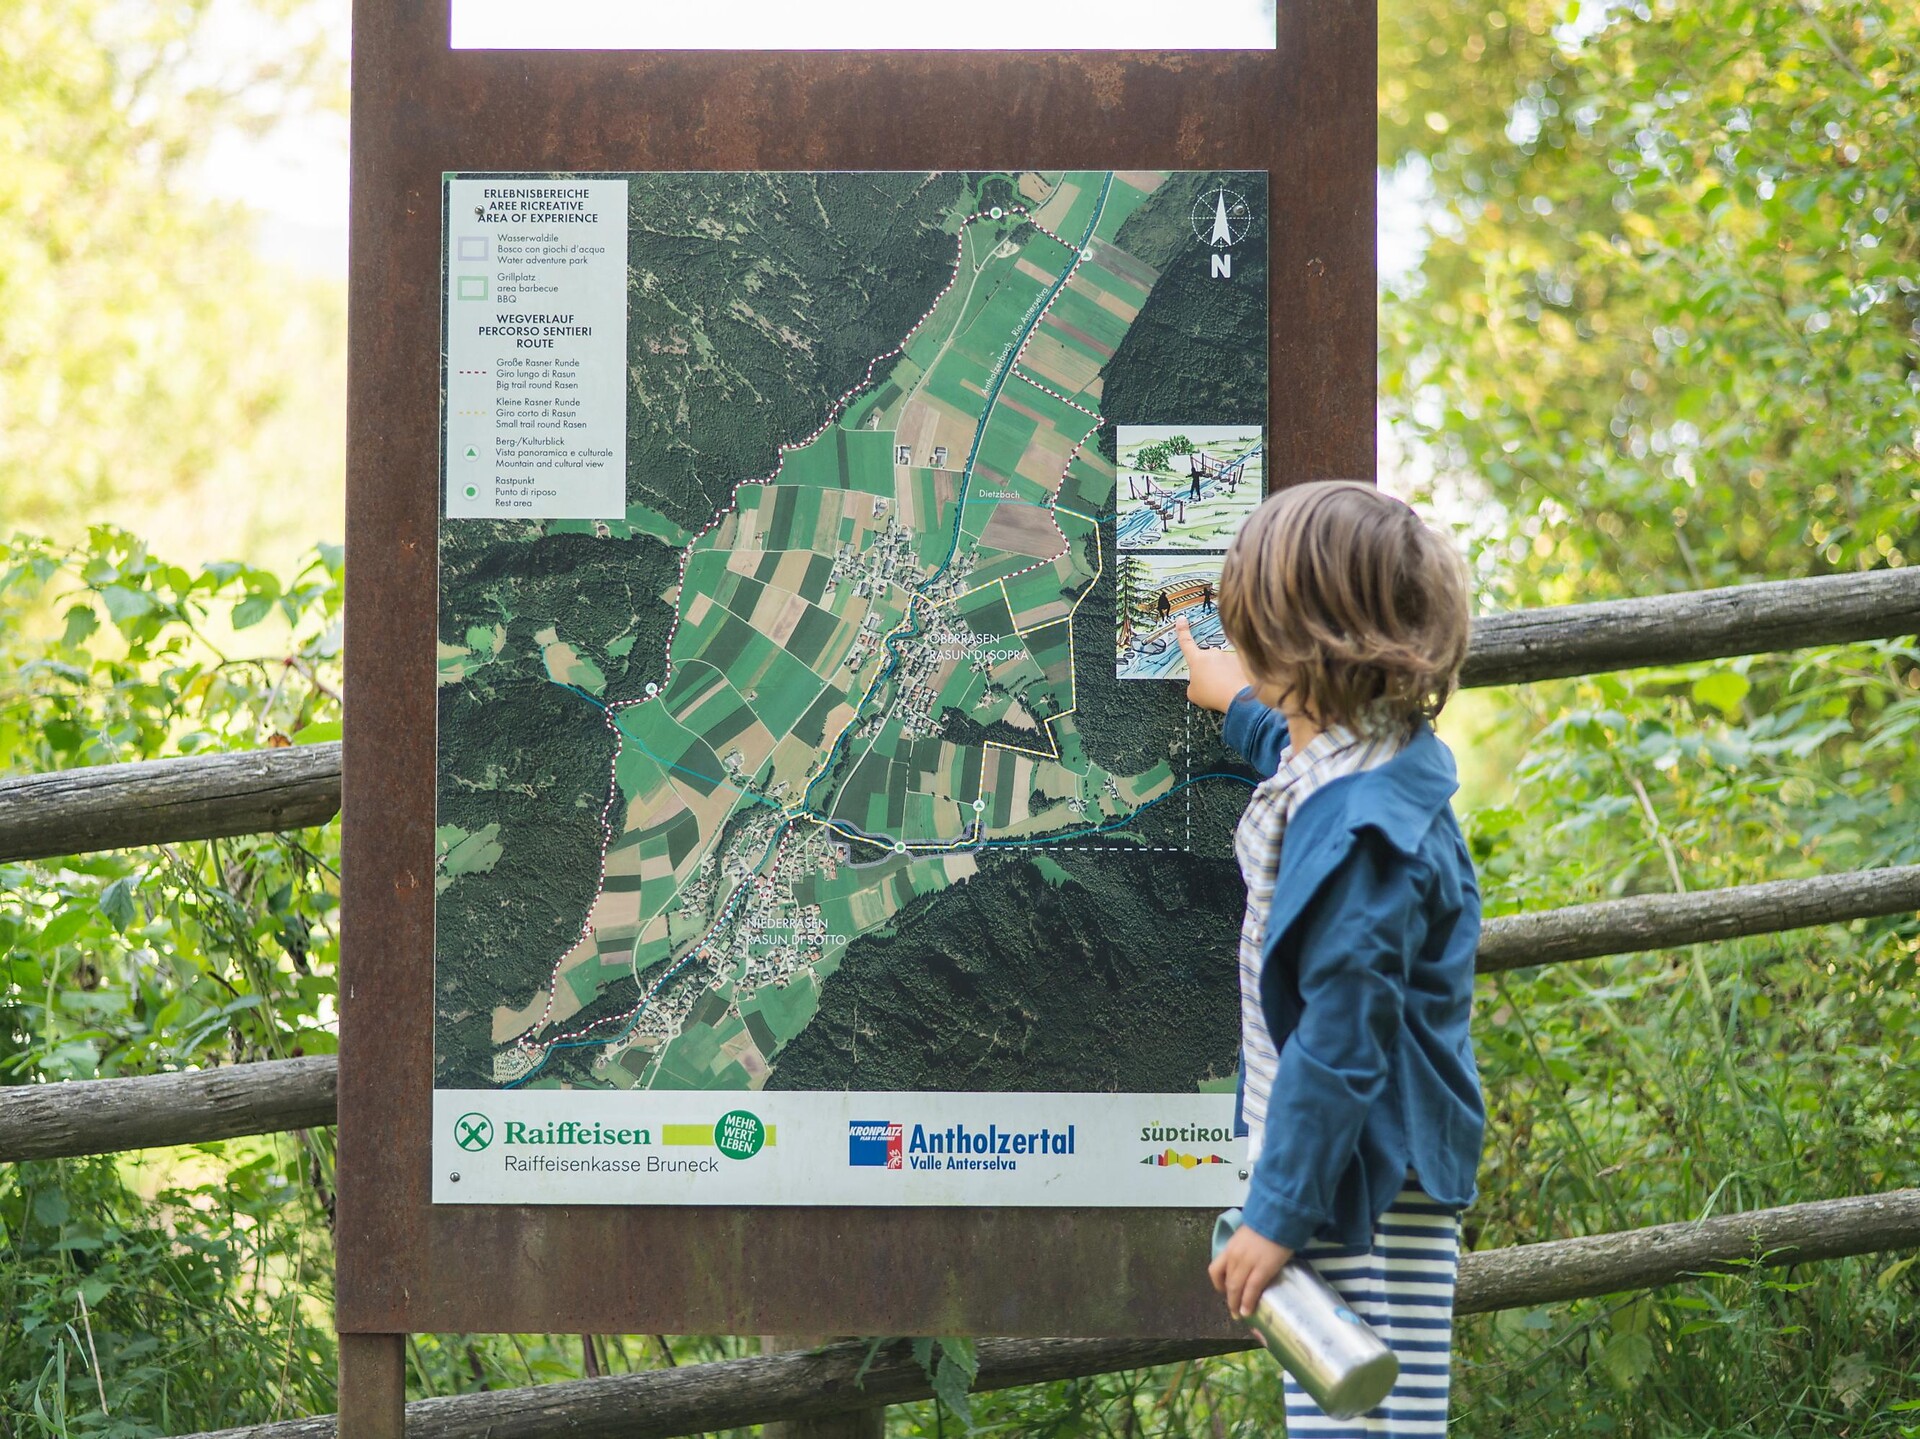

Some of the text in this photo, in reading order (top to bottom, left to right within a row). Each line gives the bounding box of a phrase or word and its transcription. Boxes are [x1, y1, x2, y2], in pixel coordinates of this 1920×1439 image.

[484, 189, 589, 198] ERLEBNISBEREICHE
[489, 201, 584, 210] AREE RICREATIVE
[478, 214, 598, 223] AREA OF EXPERIENCE
[543, 245, 568, 255] giochi
[569, 257, 588, 266] park
[1211, 254, 1231, 279] N
[497, 273, 536, 282] Grillplatz
[519, 284, 558, 292] barbecue
[497, 295, 517, 303] BBQ
[497, 315, 574, 324] WEGVERLAUF
[479, 327, 592, 336] PERCORSO SENTIERI
[517, 339, 553, 348] ROUTE
[982, 288, 1048, 396] Antholzerbach Rio Anterselva
[497, 358, 580, 367] Große Rasner Runde
[497, 369, 576, 379] Giro lungo di Rasun
[497, 380, 578, 391] Big trail round Rasen
[496, 398, 580, 406] Kleine Rasner Runde
[496, 409, 576, 417] Giro corto di Rasun
[496, 420, 587, 428] Small trail round Rasen
[496, 448, 515, 456] Vista
[518, 449, 568, 458] panoramica
[578, 448, 613, 457] culturale
[496, 459, 604, 468] Mountain and cultural view
[496, 477, 534, 486] Rastpunkt
[496, 487, 556, 497] Punto di riposo
[979, 489, 1021, 499] Dietzbach
[496, 499, 511, 507] Rest
[929, 634, 1000, 644] OBERRASEN
[929, 650, 1029, 660] RASUN DI SOPRA
[747, 919, 828, 928] NIEDERRASEN
[747, 935, 846, 945] RASUN DI SOTTO
[725, 1114, 757, 1131] MEHR.
[504, 1121, 651, 1145] Raiffeisen
[724, 1125, 755, 1143] WERT.
[850, 1126, 902, 1136] KRONPLATZ
[909, 1124, 1075, 1154] Antholzertal
[721, 1137, 754, 1154] LEBEN.
[505, 1157, 719, 1172] Raiffeisenkasse Bruneck
[910, 1156, 1016, 1170] Valle Anterselva
